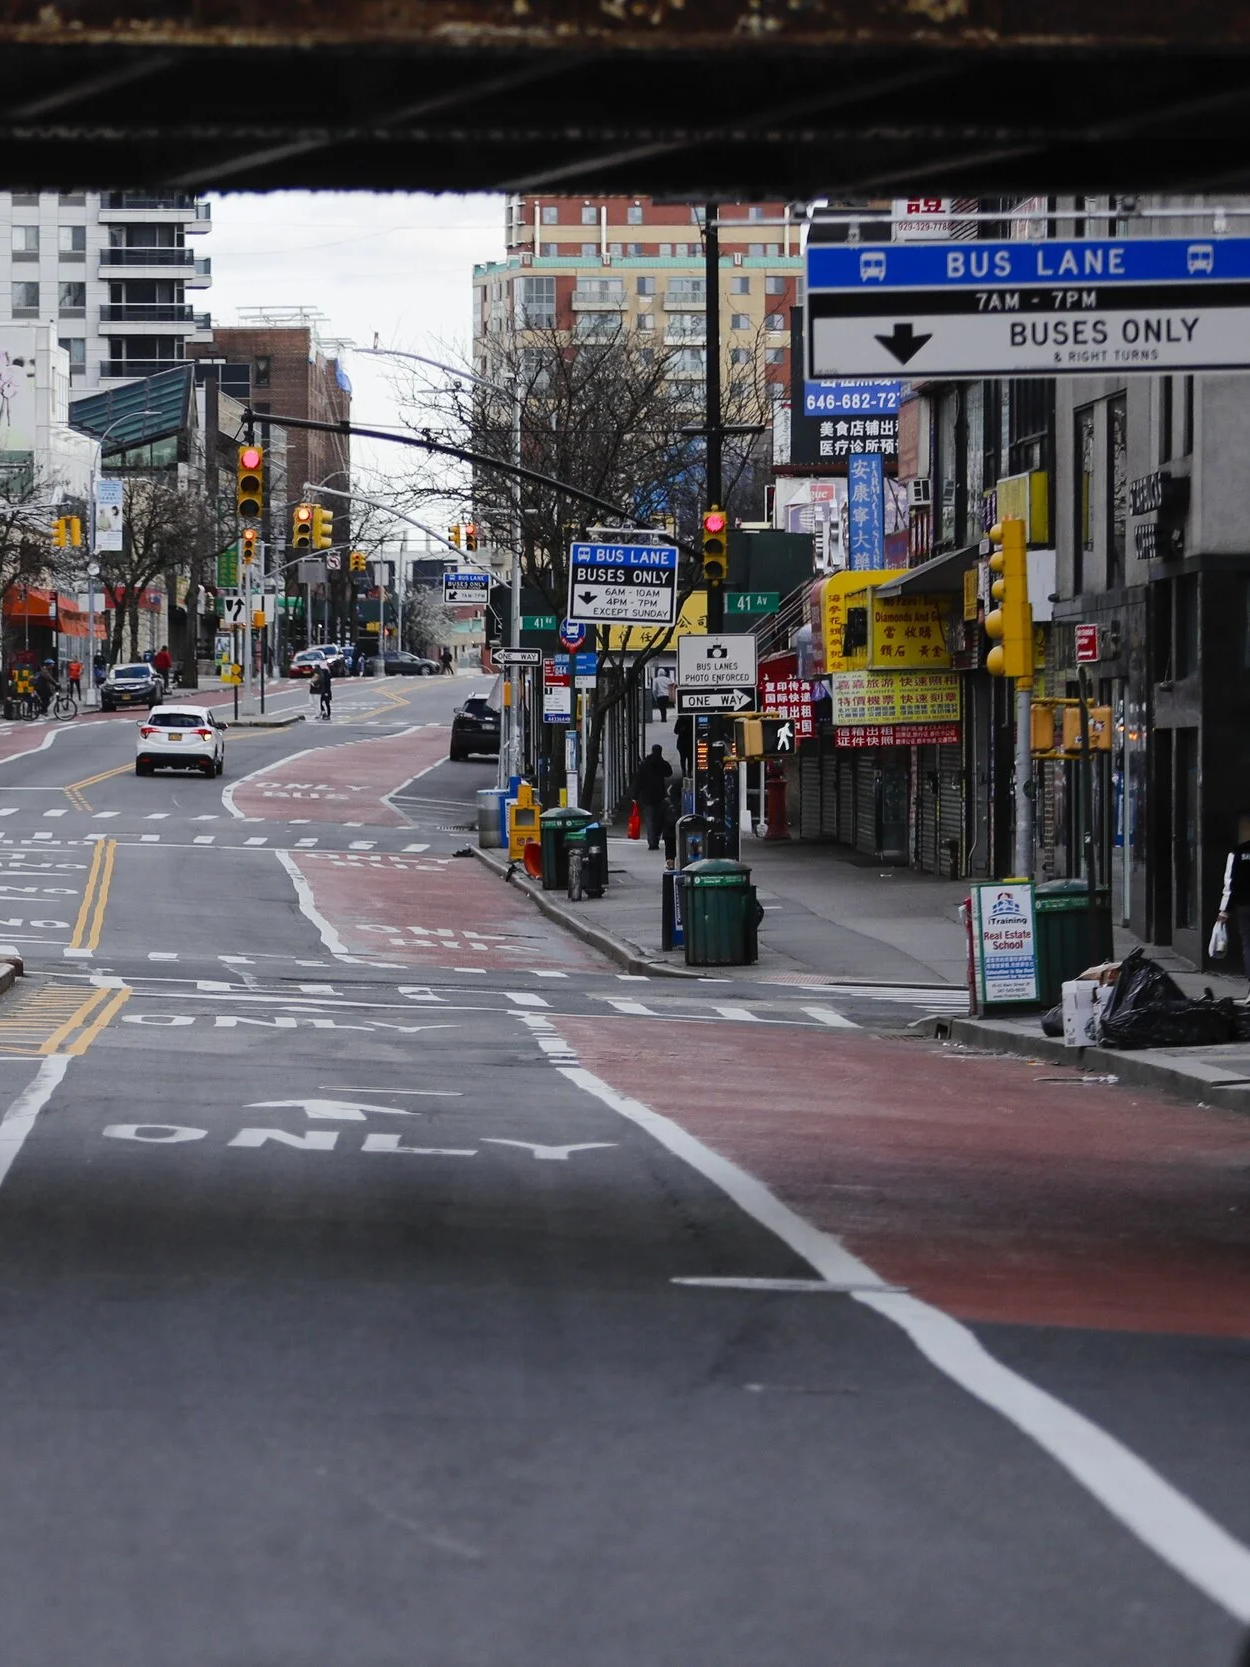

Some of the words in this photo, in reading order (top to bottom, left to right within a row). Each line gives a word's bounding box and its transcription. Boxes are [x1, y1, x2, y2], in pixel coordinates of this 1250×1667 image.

[947, 251, 1012, 278] BUS
[1037, 248, 1126, 276] LANE
[976, 291, 1020, 311] 7AM
[1051, 290, 1097, 309] 7PM
[1010, 320, 1108, 347] BUSES
[1122, 317, 1199, 344] ONLY
[1054, 352, 1062, 362] &
[1068, 350, 1107, 362] RIGHT
[1113, 349, 1159, 361] TURNS
[806, 393, 900, 410] 646-682-72
[820, 420, 899, 437] 美食店铺出
[596, 549, 624, 563] BUS
[630, 550, 669, 565] LANE
[577, 568, 625, 583] BUSES
[633, 570, 670, 584] ONLY
[605, 587, 626, 596] 6AM
[636, 589, 660, 597] 10AM
[606, 598, 627, 606] 4PM
[638, 599, 658, 607] 7PM
[737, 595, 751, 611] 41
[593, 607, 629, 616] EXCEPT
[632, 609, 669, 618] SUNDAY
[534, 618, 544, 628] 41
[696, 663, 711, 671] BUS
[714, 663, 738, 671] LANES
[685, 674, 709, 682] PHOTO
[712, 674, 750, 682] ENFORCED
[688, 696, 711, 706] ONE
[720, 695, 744, 705] WAY
[255, 782, 372, 791] ONLY
[988, 917, 1027, 925] iTraining
[355, 924, 506, 941] ONL
[984, 931, 1002, 940] Real
[1005, 930, 1031, 940] Estate
[993, 940, 1023, 950] School
[121, 1015, 462, 1033] ONLY
[102, 1124, 619, 1160] ONLY
